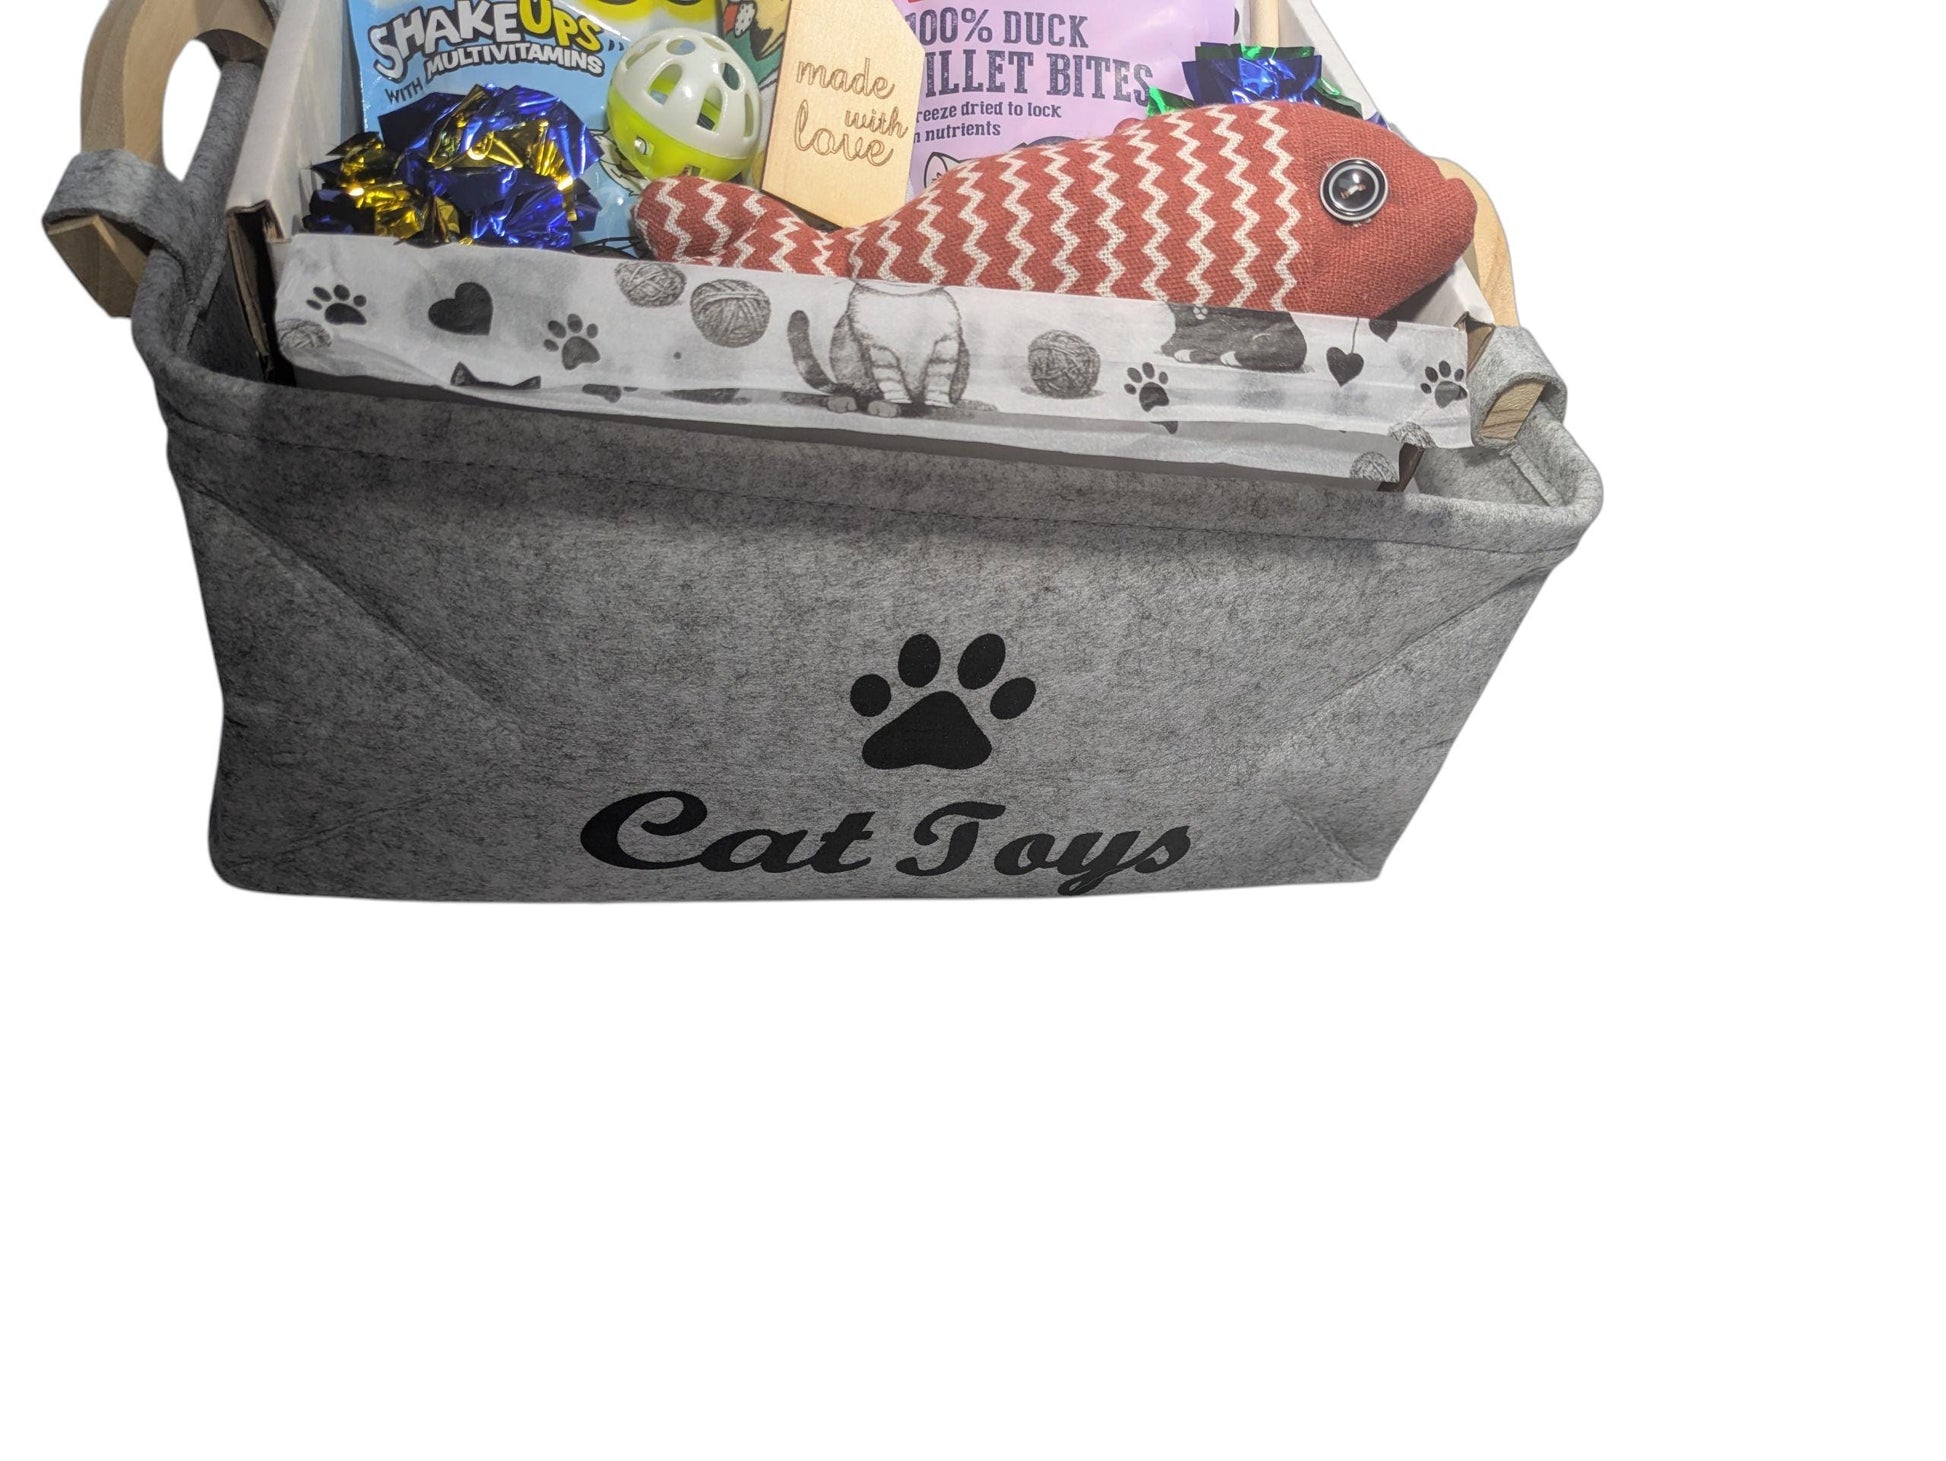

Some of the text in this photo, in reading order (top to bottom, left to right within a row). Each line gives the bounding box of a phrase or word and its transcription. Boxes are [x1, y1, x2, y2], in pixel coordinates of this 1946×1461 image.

[1003, 10, 1089, 48] DUCK
[385, 42, 606, 105] WITH MULTIVITAMINS
[796, 57, 896, 99] made
[924, 49, 1154, 106] ILLET BITES
[794, 99, 894, 166] love
[844, 106, 909, 138] with
[916, 101, 1062, 123] reeze dried to lock
[925, 121, 1001, 142] nutrients
[580, 790, 1192, 896] Cat Toys
